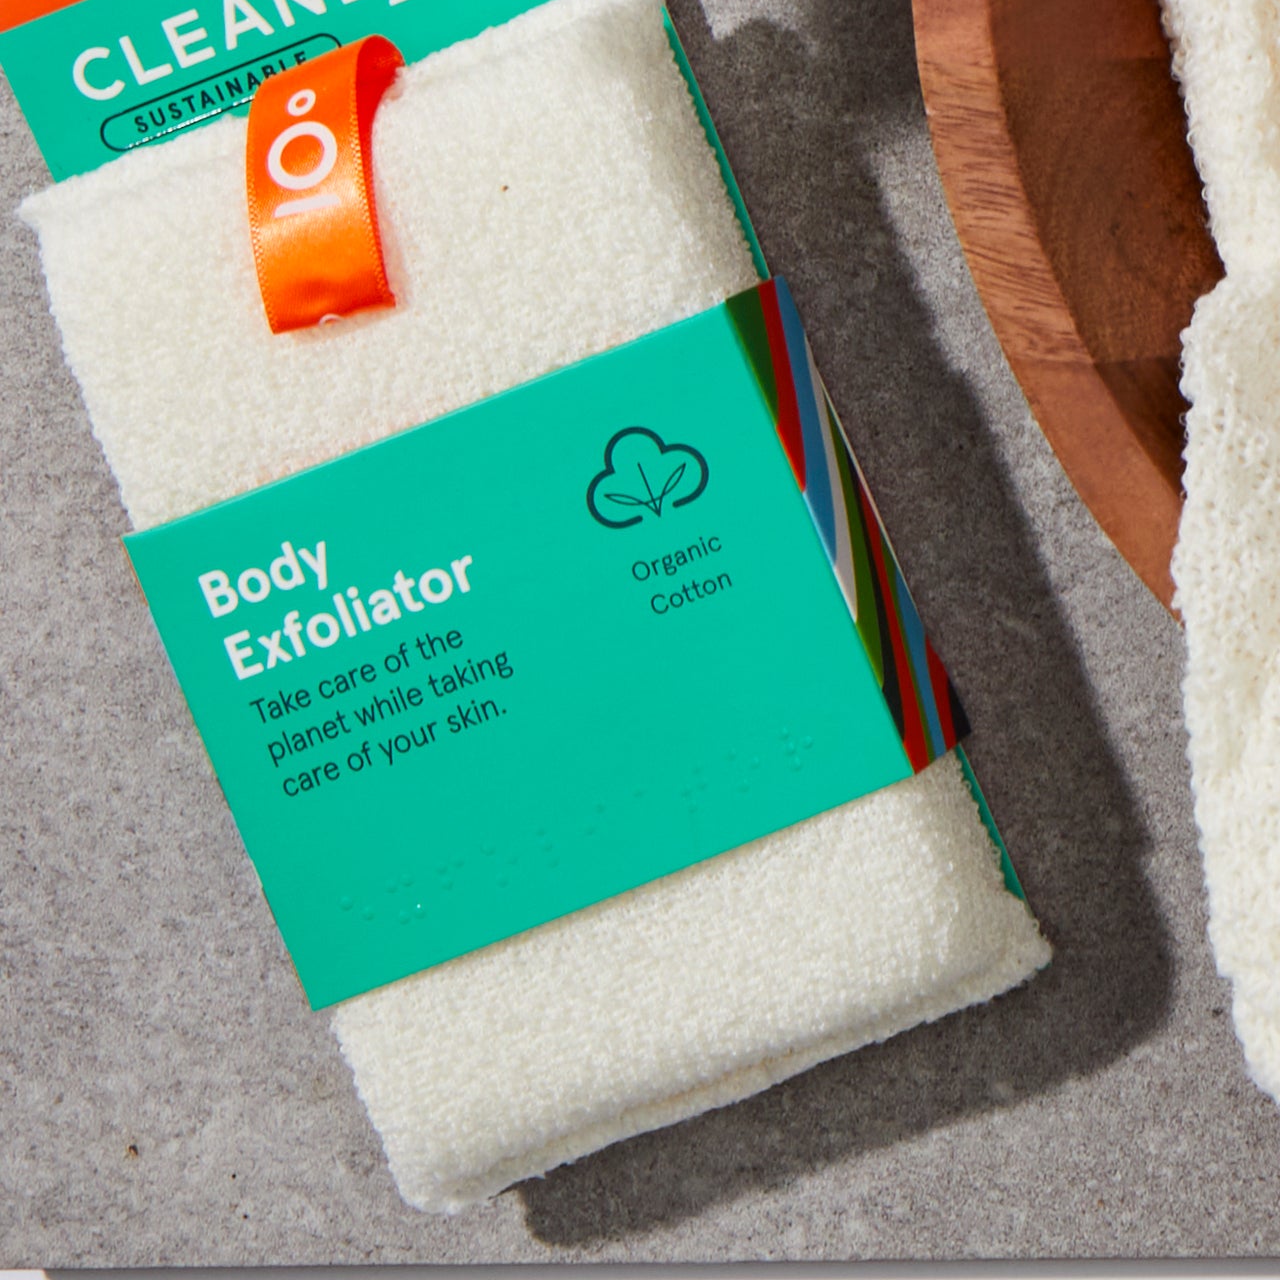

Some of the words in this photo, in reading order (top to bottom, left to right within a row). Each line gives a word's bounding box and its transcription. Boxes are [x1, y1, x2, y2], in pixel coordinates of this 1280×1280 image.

[198, 540, 328, 618] Body
[631, 536, 722, 582] Organic
[650, 572, 733, 615] Cotton
[223, 554, 473, 680] Exfoliator
[249, 688, 312, 724] Take
[318, 662, 377, 699] care
[383, 642, 410, 673] of
[415, 629, 464, 661] the
[267, 710, 351, 768] planet
[353, 686, 424, 727] while
[427, 651, 514, 698] taking
[282, 761, 341, 798] care
[347, 740, 373, 772] of
[378, 721, 438, 766] your
[446, 696, 508, 734] skin.
